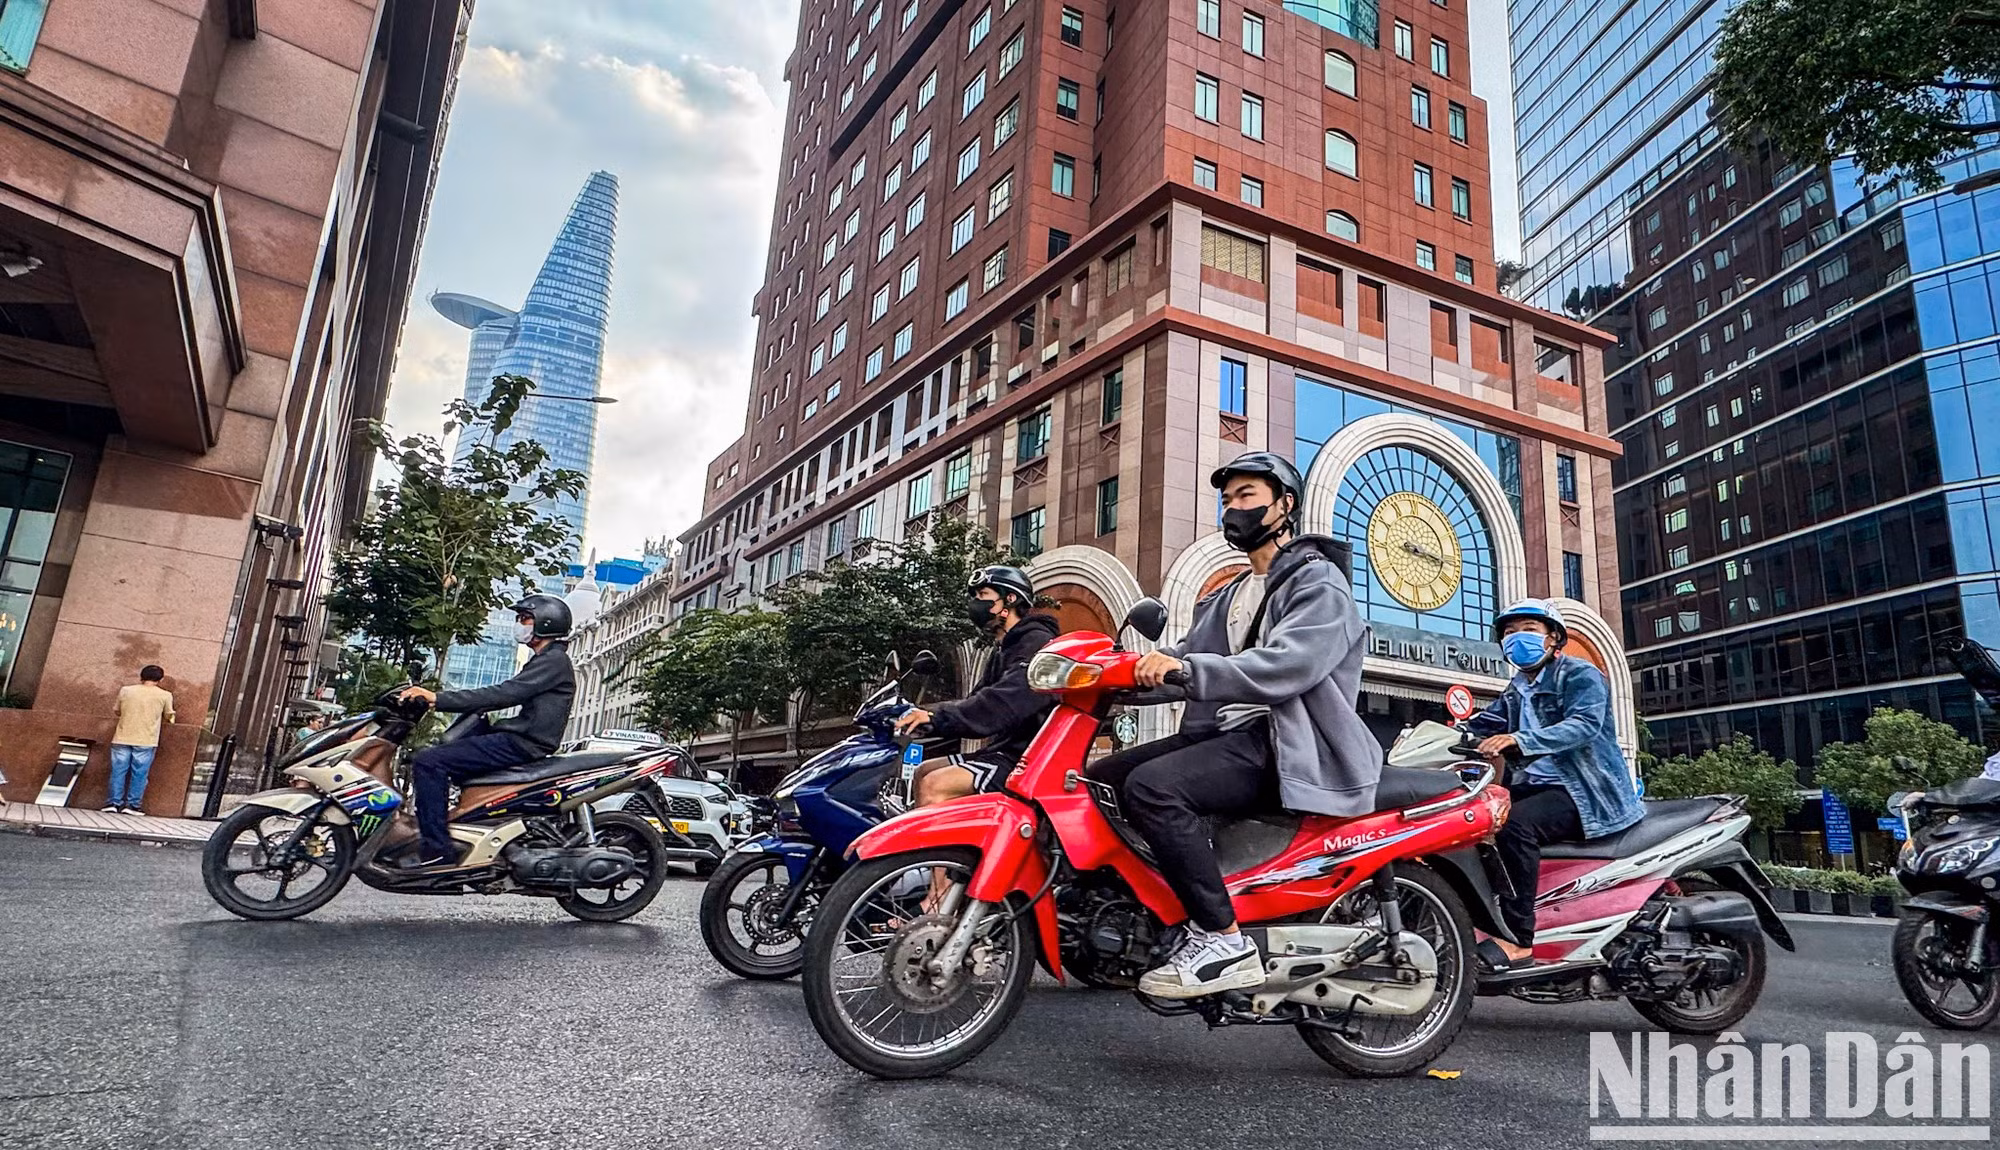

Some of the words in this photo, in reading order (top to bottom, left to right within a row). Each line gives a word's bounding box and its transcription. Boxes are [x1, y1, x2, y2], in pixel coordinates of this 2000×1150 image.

[1444, 644, 1501, 675] POINT
[615, 731, 646, 740] VINASUN
[910, 748, 919, 760] P
